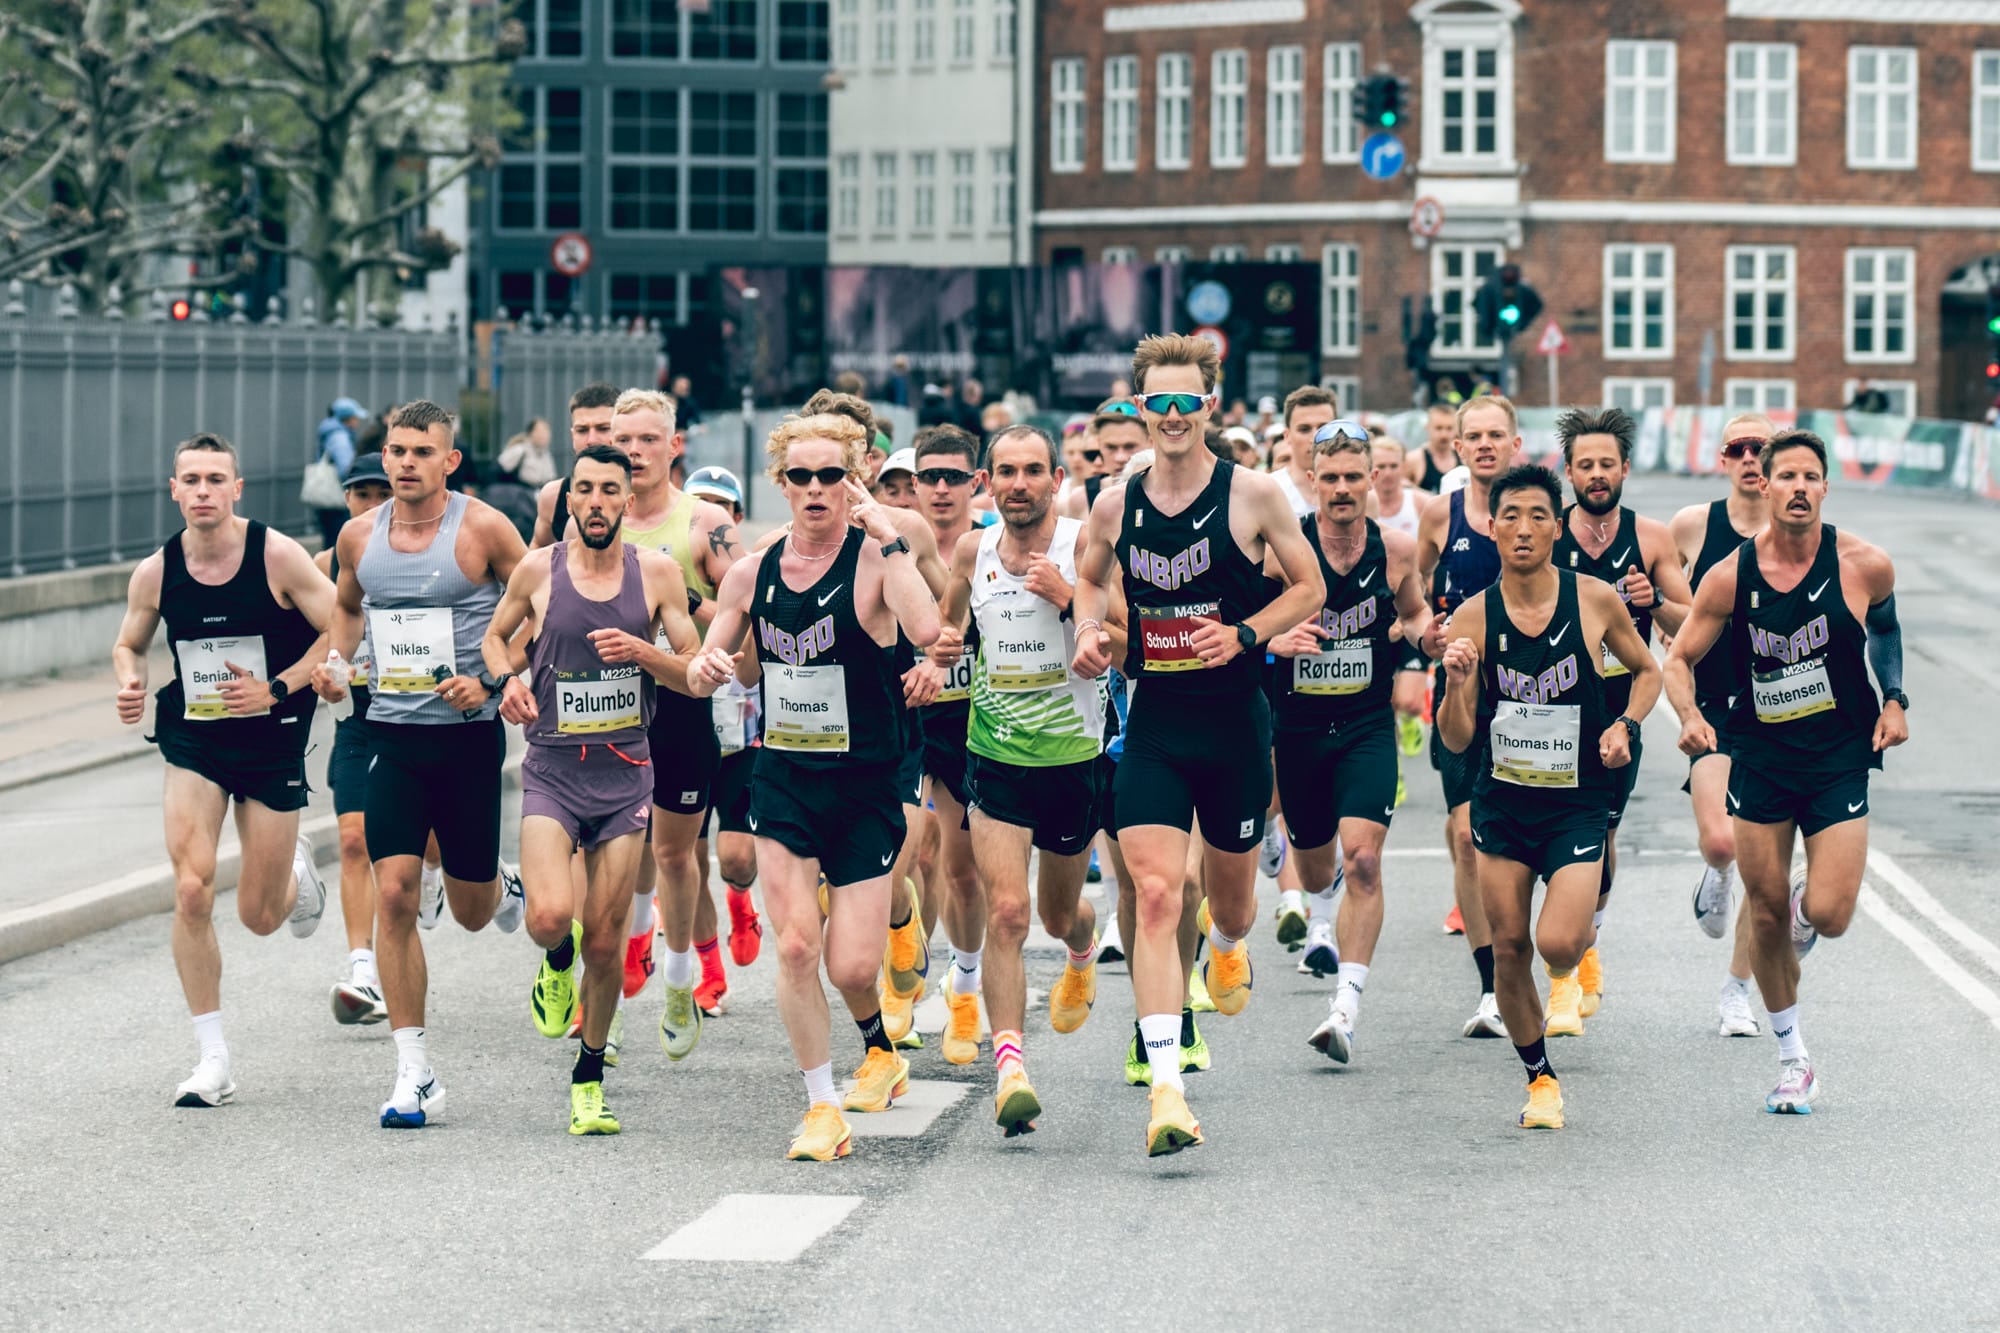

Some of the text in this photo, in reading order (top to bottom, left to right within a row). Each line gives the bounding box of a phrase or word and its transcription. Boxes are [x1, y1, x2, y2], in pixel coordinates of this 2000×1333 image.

[1130, 537, 1211, 591] NBRO
[1174, 603, 1210, 618] M430
[1315, 595, 1377, 640] BRO
[760, 614, 836, 666] NBRO
[998, 639, 1046, 653] Frankie
[1146, 631, 1178, 649] Schou
[1333, 638, 1364, 650] M228
[1747, 613, 1830, 664] NBRO
[391, 643, 431, 656] Niklas
[601, 666, 633, 681] M223
[1039, 662, 1063, 672] 12734
[1299, 657, 1367, 679] Rørdam
[1782, 659, 1816, 678] M200
[1496, 653, 1579, 705] NBRO
[563, 688, 636, 713] Palumbo
[1755, 680, 1826, 707] Kristensen
[778, 696, 829, 713] Thomas
[821, 724, 844, 733] 16701
[1496, 733, 1573, 751] Thomas Ho
[1551, 762, 1573, 771] 21737
